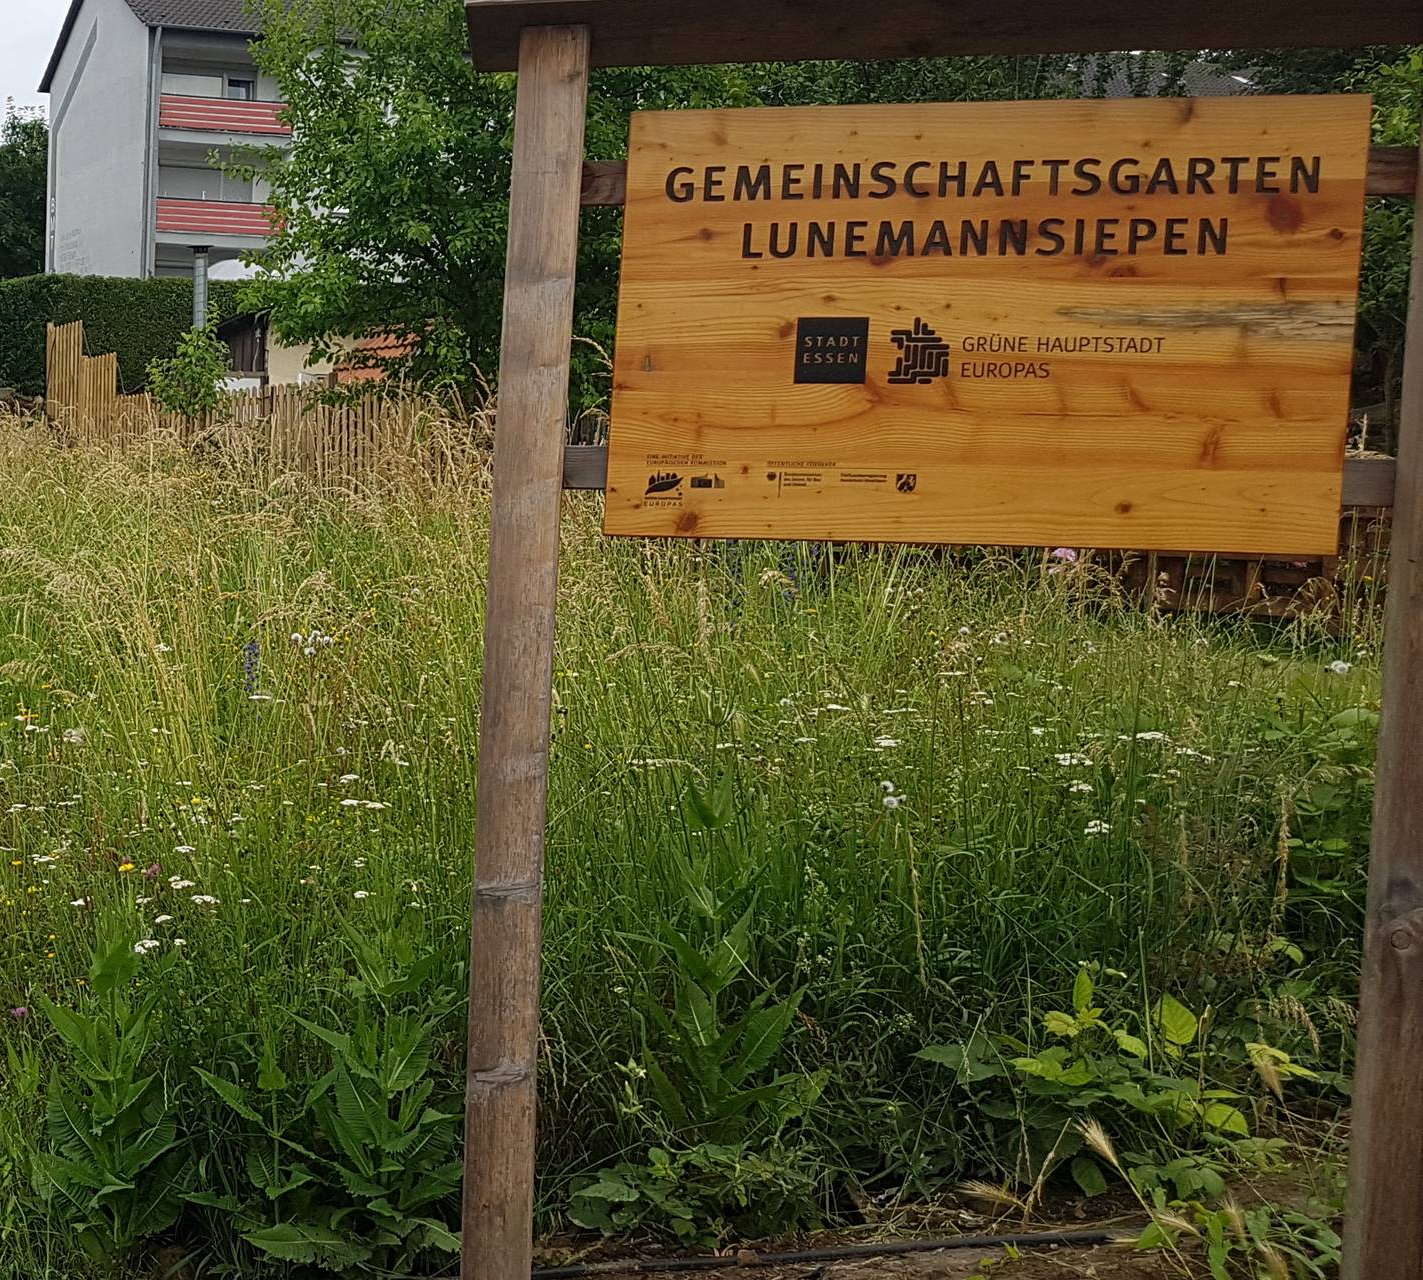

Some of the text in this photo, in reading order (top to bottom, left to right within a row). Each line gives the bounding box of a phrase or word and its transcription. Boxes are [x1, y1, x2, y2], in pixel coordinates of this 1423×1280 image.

[664, 156, 1322, 203] GEMEINSCHAFTSGARTEN
[741, 217, 1230, 260] LUNEMANNSIEPEN
[804, 335, 861, 349] STADT
[962, 333, 1166, 354] GRÜNE HAUPTSTADT
[802, 352, 859, 365] ESSEN
[961, 362, 1050, 379] EUROPAS
[643, 500, 683, 508] EUROPAS
